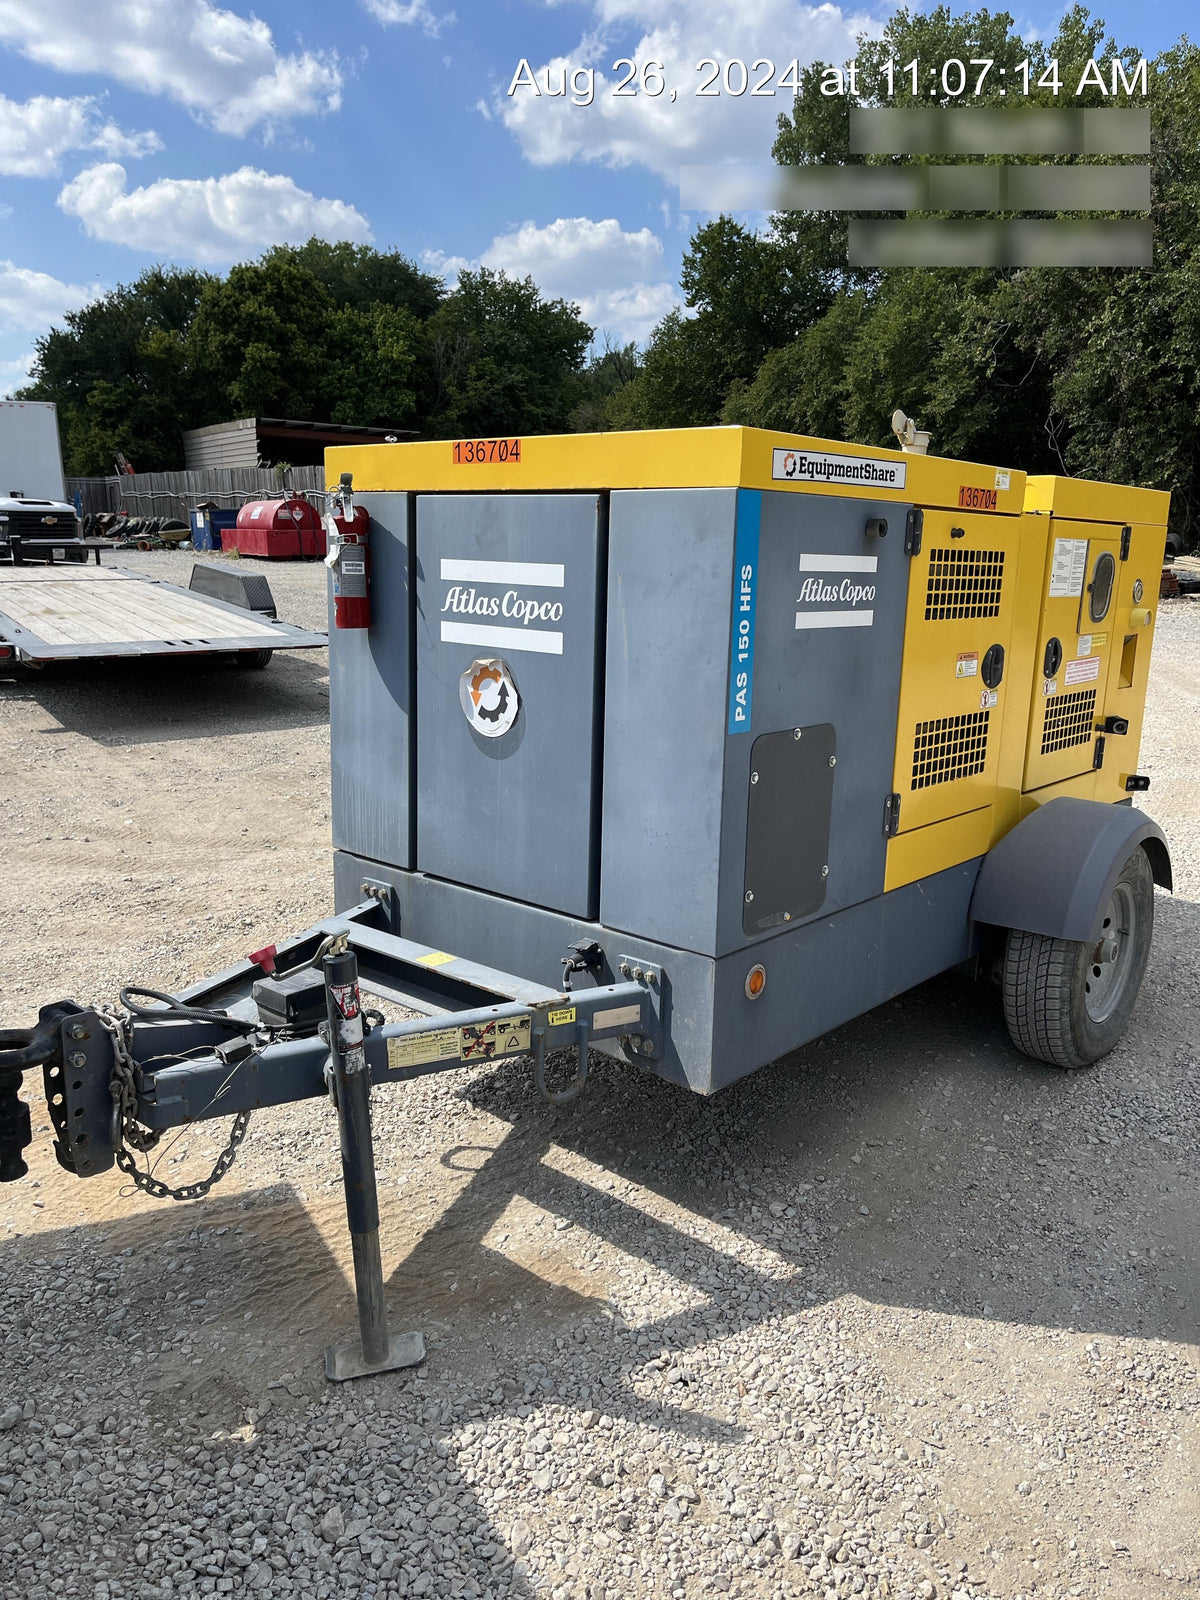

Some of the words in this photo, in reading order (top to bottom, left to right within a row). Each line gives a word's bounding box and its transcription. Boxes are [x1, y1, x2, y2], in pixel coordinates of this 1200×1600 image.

[454, 439, 520, 463] 136704
[798, 456, 896, 483] EquipmentShare
[960, 486, 998, 510] 136704
[739, 564, 753, 612] HFS
[796, 577, 839, 603] Atlas
[839, 578, 876, 606] Copco
[440, 586, 500, 617] Atlas
[501, 590, 564, 625] Copco
[738, 619, 750, 663] 150
[735, 672, 748, 722] PAS
